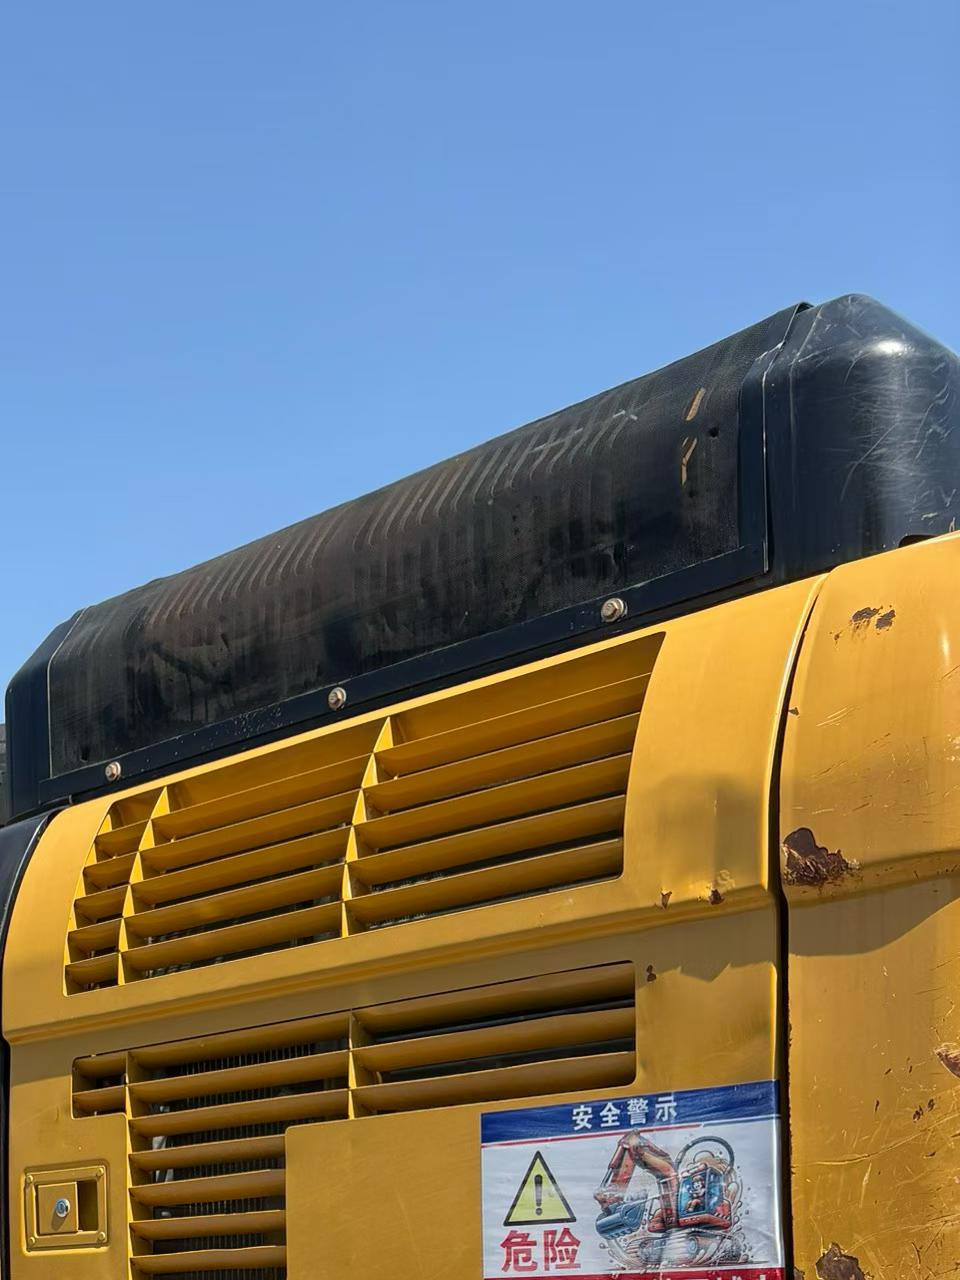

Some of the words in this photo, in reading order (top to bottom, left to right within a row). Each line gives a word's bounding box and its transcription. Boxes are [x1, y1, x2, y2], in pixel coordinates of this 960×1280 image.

[572, 1096, 677, 1131] 安全警示
[500, 1227, 581, 1272] 危险
